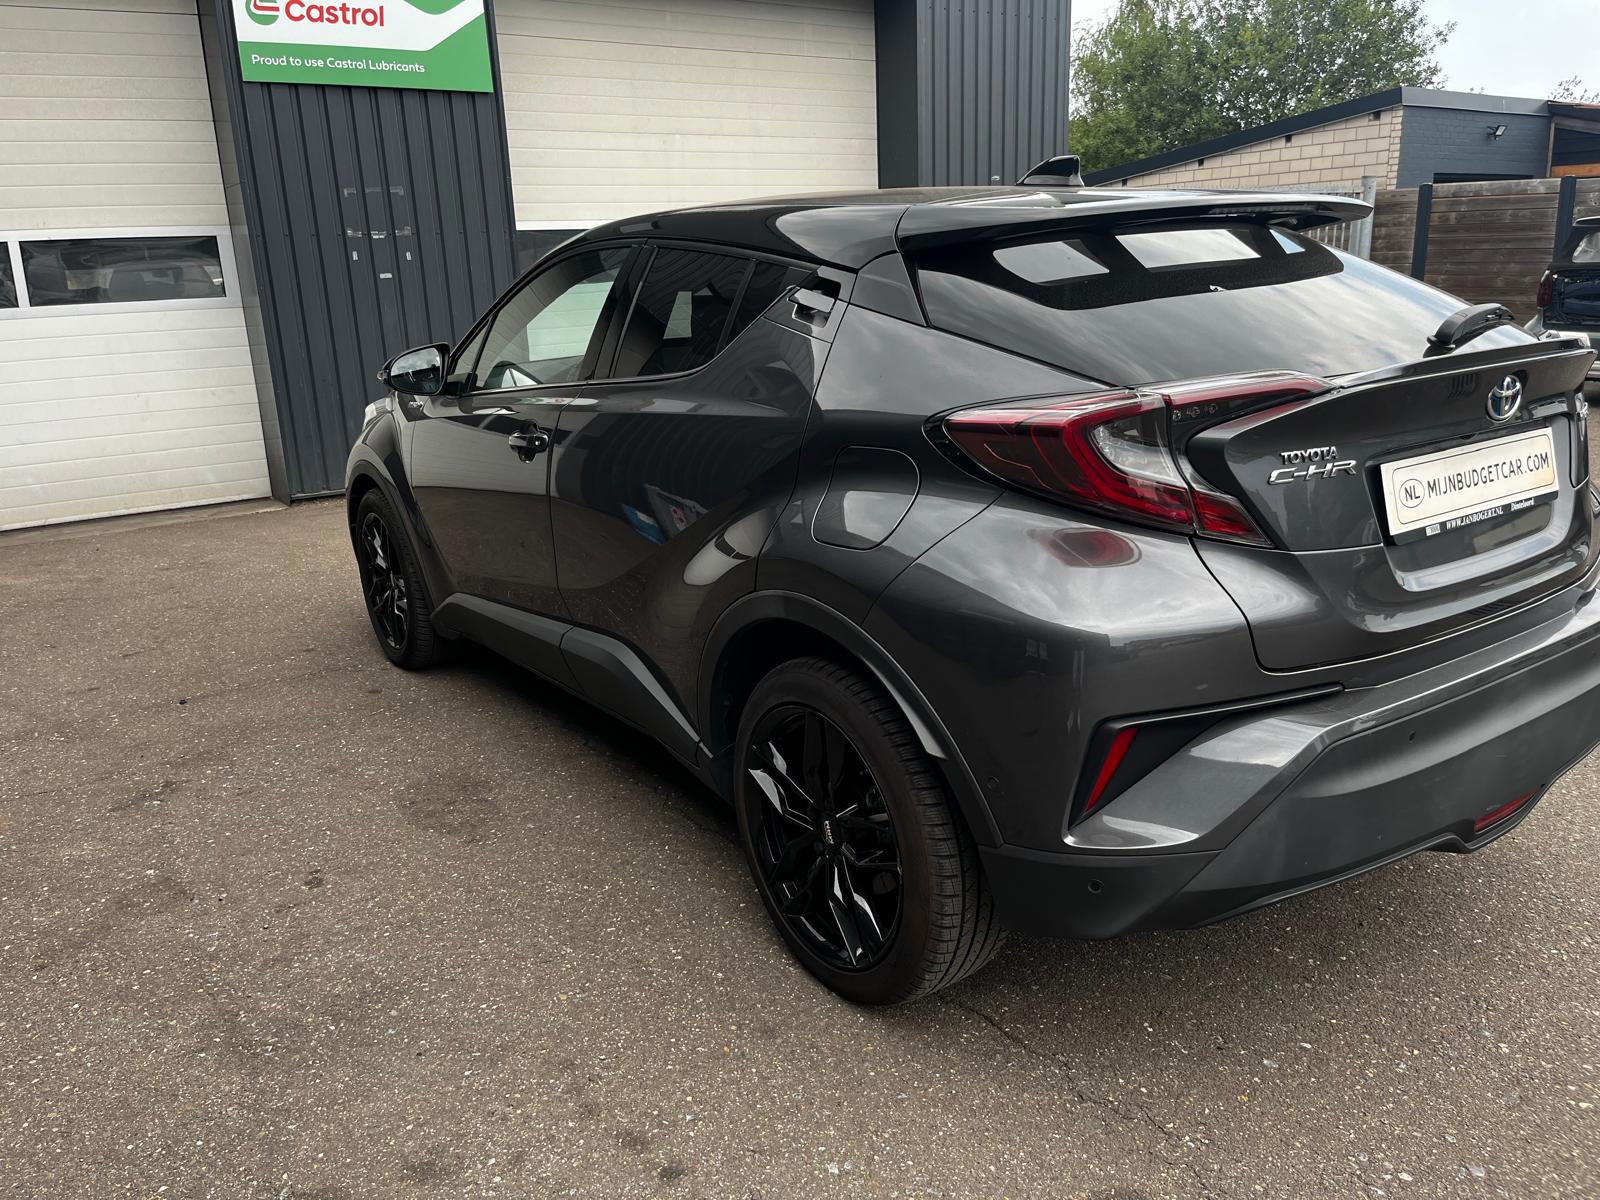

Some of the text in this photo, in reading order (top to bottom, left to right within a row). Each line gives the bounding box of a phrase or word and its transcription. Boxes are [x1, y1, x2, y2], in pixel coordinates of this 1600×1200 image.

[285, 0, 384, 26] Castrol
[251, 54, 425, 73] Proud to use Castrol Lubricants
[1279, 446, 1339, 465] TOYOTA
[1268, 460, 1357, 485] C-HR
[1404, 452, 1550, 501] NL MIJNBUDGETCAR.COM
